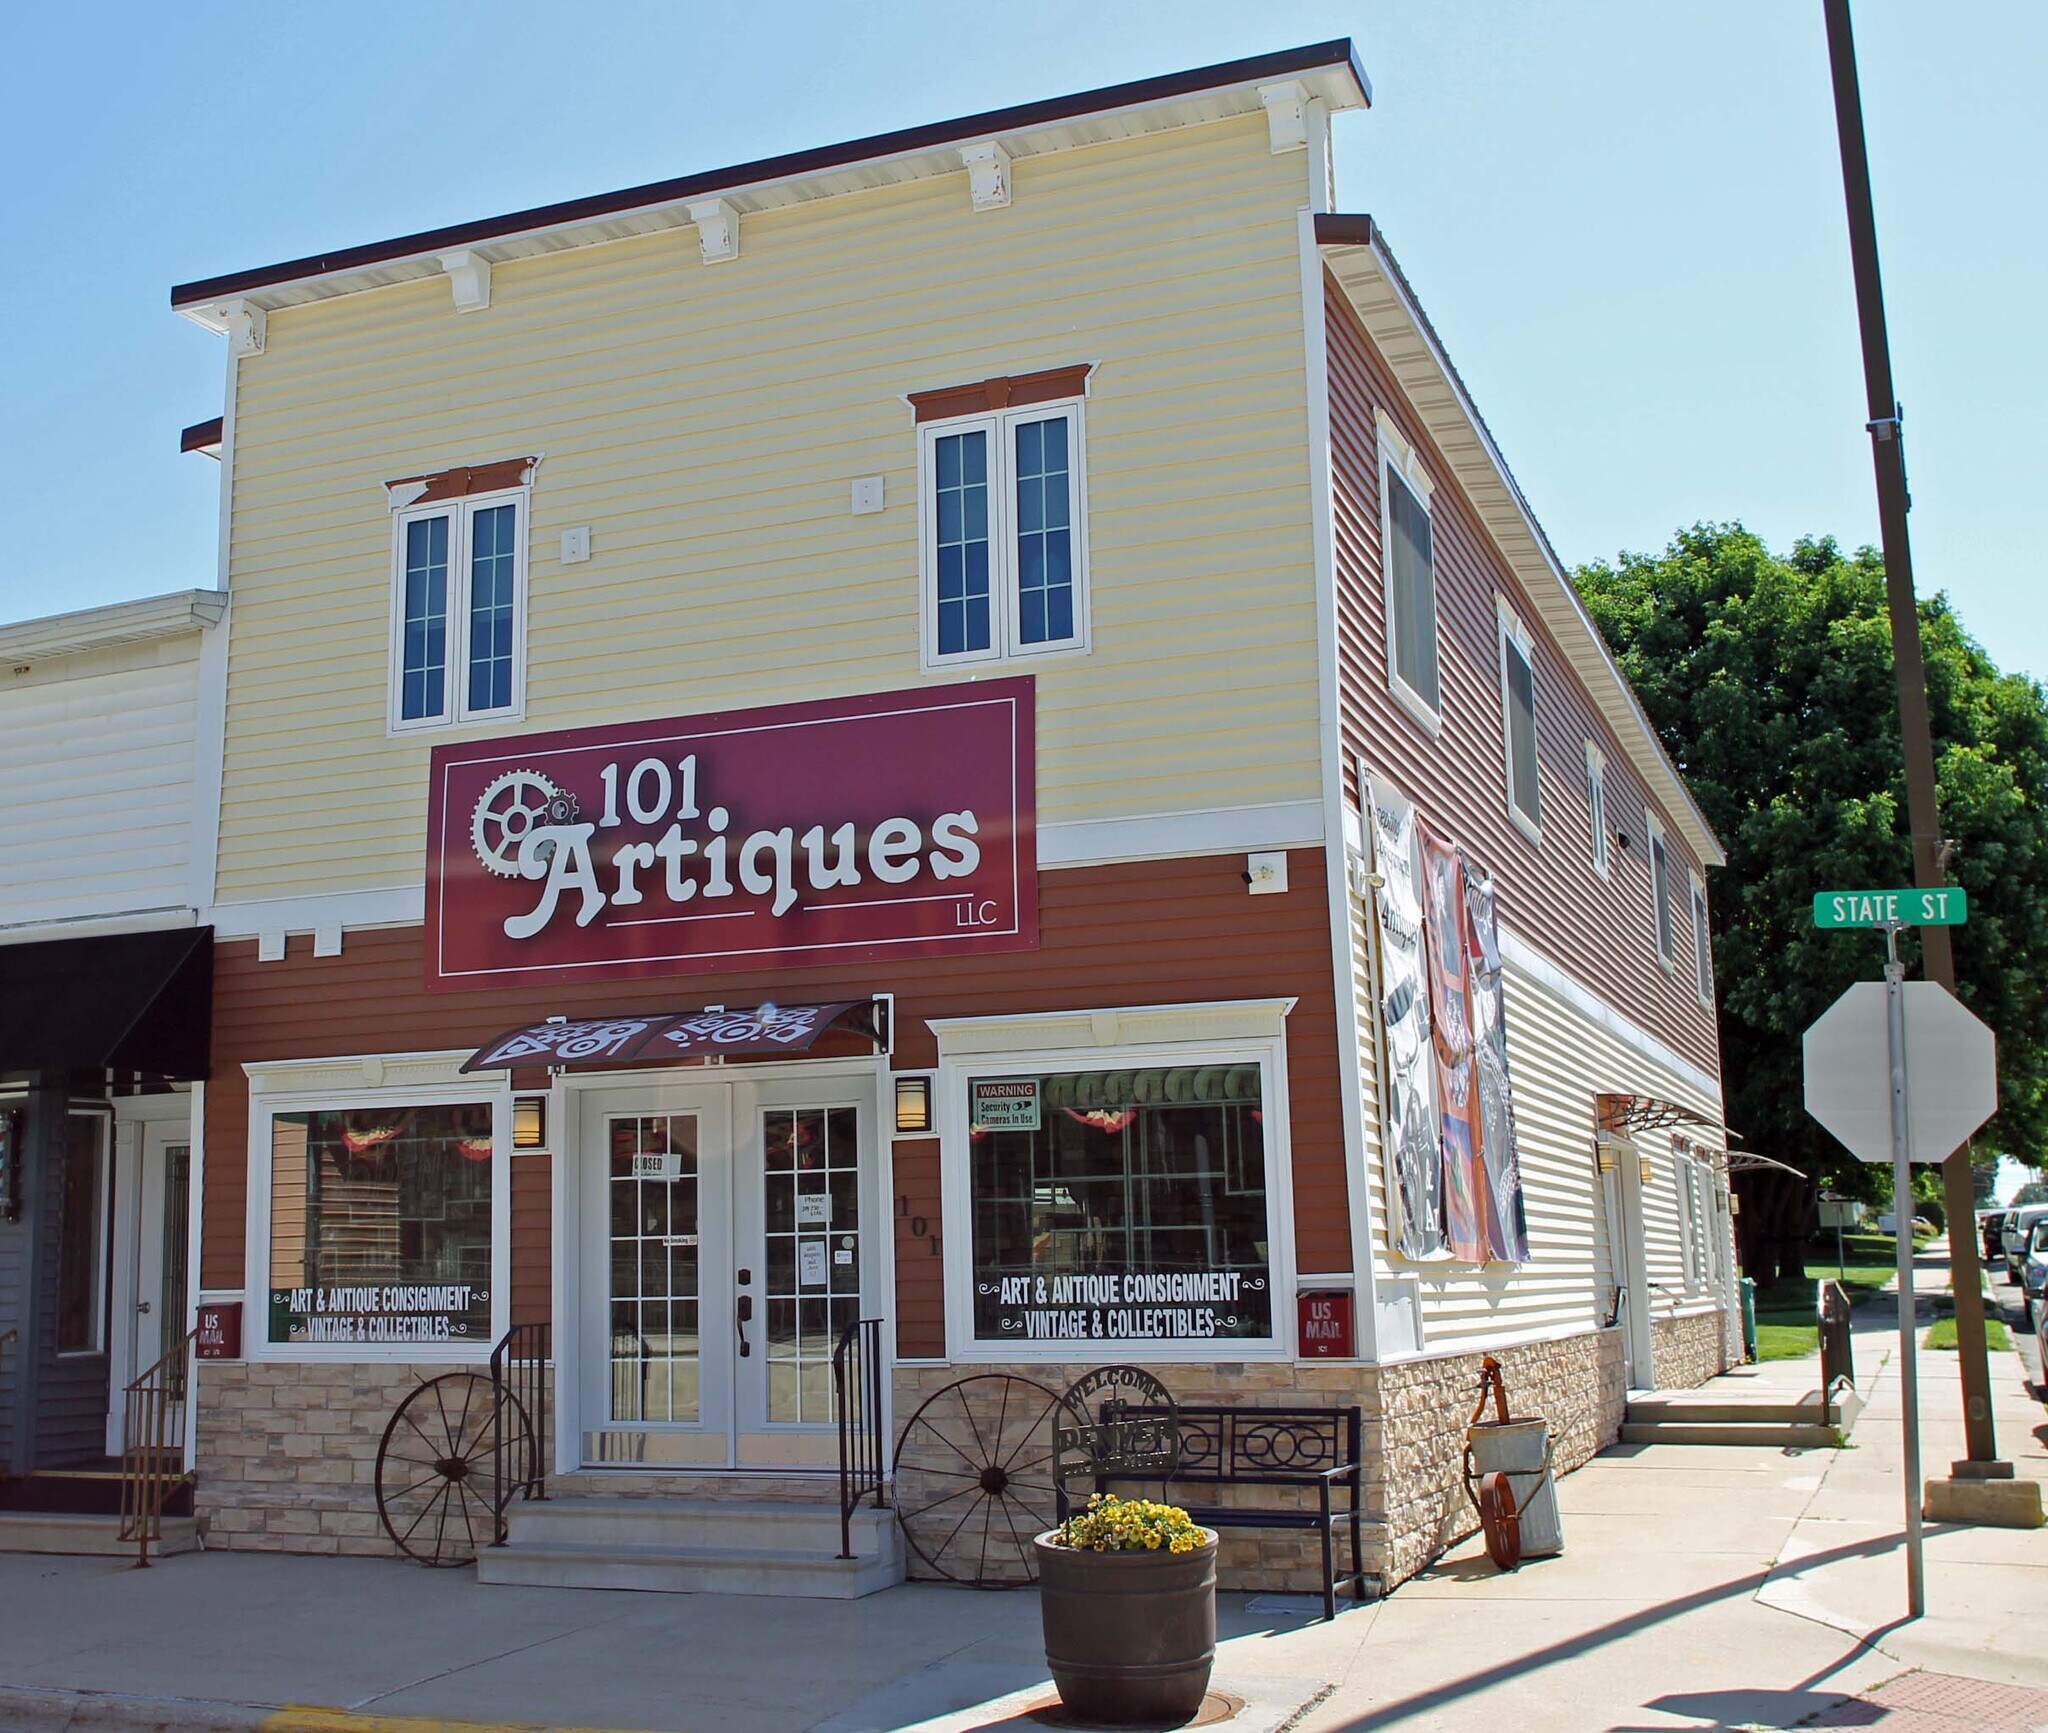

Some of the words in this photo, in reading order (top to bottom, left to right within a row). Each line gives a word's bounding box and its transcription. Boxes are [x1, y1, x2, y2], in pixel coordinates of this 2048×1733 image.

[600, 754, 700, 828] 101
[503, 806, 981, 939] Artiques
[956, 900, 998, 927] LLC
[1833, 895, 1899, 922] STATE
[1921, 893, 1948, 920] ST
[980, 1084, 1033, 1097] WARNING
[981, 1101, 1011, 1113] Security
[981, 1114, 1010, 1125] Cameras
[1012, 1114, 1019, 1124] In
[1020, 1114, 1033, 1124] Use
[290, 1288, 313, 1313] ART
[316, 1287, 326, 1309] &
[328, 1286, 380, 1315] ANTIQUE
[382, 1285, 471, 1312] CONSIGNMENT
[1001, 1276, 1031, 1305] ART
[1035, 1276, 1048, 1304] &
[1052, 1274, 1120, 1307] ANTIQUE
[1123, 1272, 1241, 1303] CONSIGNMENT
[204, 1314, 219, 1330] US
[1024, 1310, 1087, 1339] VINTAGE
[1091, 1309, 1104, 1338] &
[1107, 1307, 1215, 1338] COLLECTIBLES
[1311, 1301, 1332, 1320] US
[199, 1329, 225, 1344] MAIL
[307, 1317, 354, 1341] VINTAGE
[356, 1316, 365, 1340] &
[368, 1315, 450, 1341] COLLECTIBLES
[1305, 1320, 1343, 1339] MAIL
[1067, 1367, 1166, 1410] WELCOME
